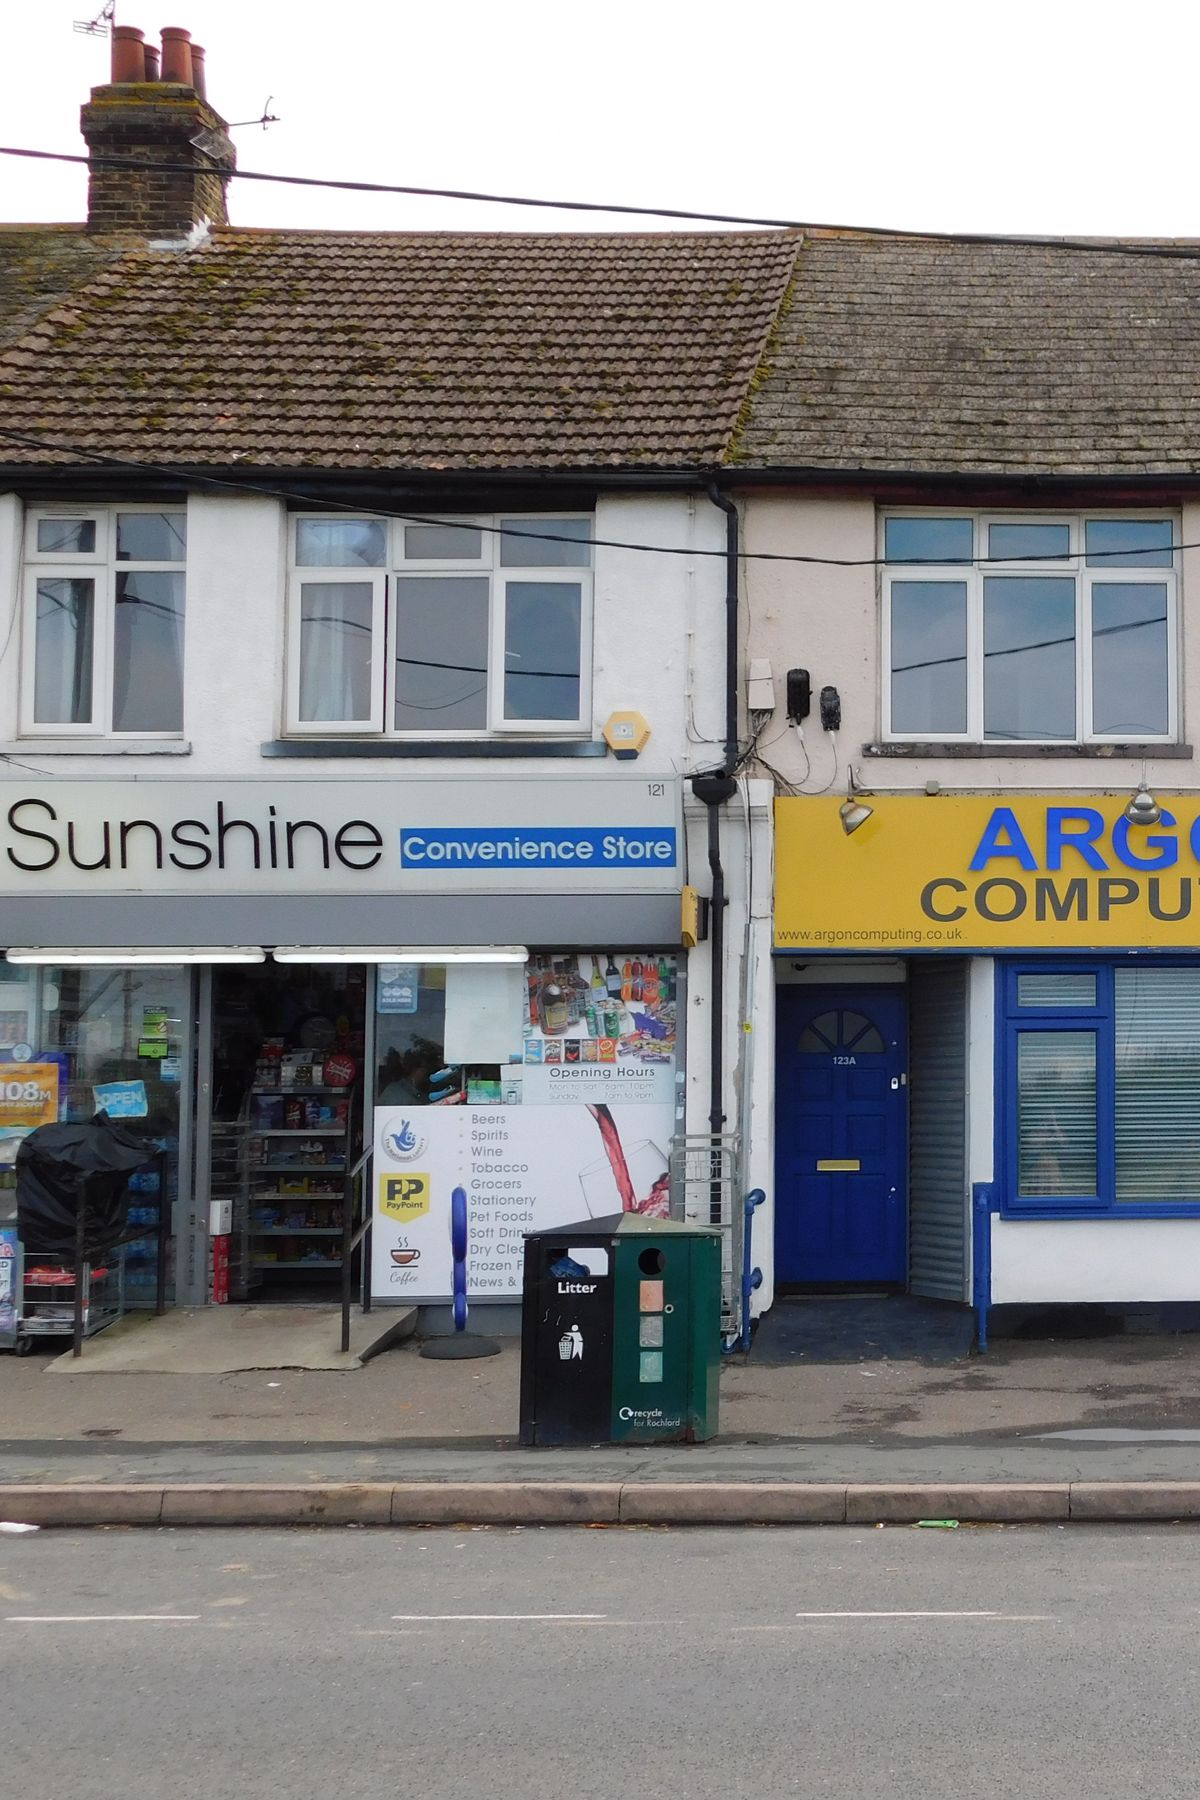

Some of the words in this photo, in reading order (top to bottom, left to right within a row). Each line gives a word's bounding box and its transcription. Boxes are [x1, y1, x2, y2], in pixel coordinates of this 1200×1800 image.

[647, 784, 665, 797] 121
[7, 798, 384, 871] Sunshine
[403, 836, 594, 861] Convenience
[602, 835, 672, 860] Store
[777, 928, 962, 943] www.argoncomputing.co.uk
[832, 1056, 857, 1065] 123A
[550, 1068, 611, 1080] Opening
[617, 1067, 656, 1077] Hours
[471, 1114, 507, 1125] Beers
[471, 1130, 510, 1142] Spirits
[471, 1146, 503, 1157] Wine
[471, 1162, 529, 1173] Tobacco
[471, 1179, 523, 1190] Grocers
[386, 1201, 423, 1209] PayPoint
[470, 1195, 537, 1207] Stationery
[470, 1211, 490, 1222] Pet
[495, 1211, 534, 1222] Foods
[470, 1228, 494, 1239] Soft
[470, 1244, 492, 1257] Dry
[470, 1260, 512, 1271] Frozen
[389, 1272, 419, 1285] Coffee
[470, 1276, 504, 1288] News
[508, 1276, 517, 1287] &
[557, 1281, 598, 1295] Litter
[634, 1408, 663, 1419] recycle
